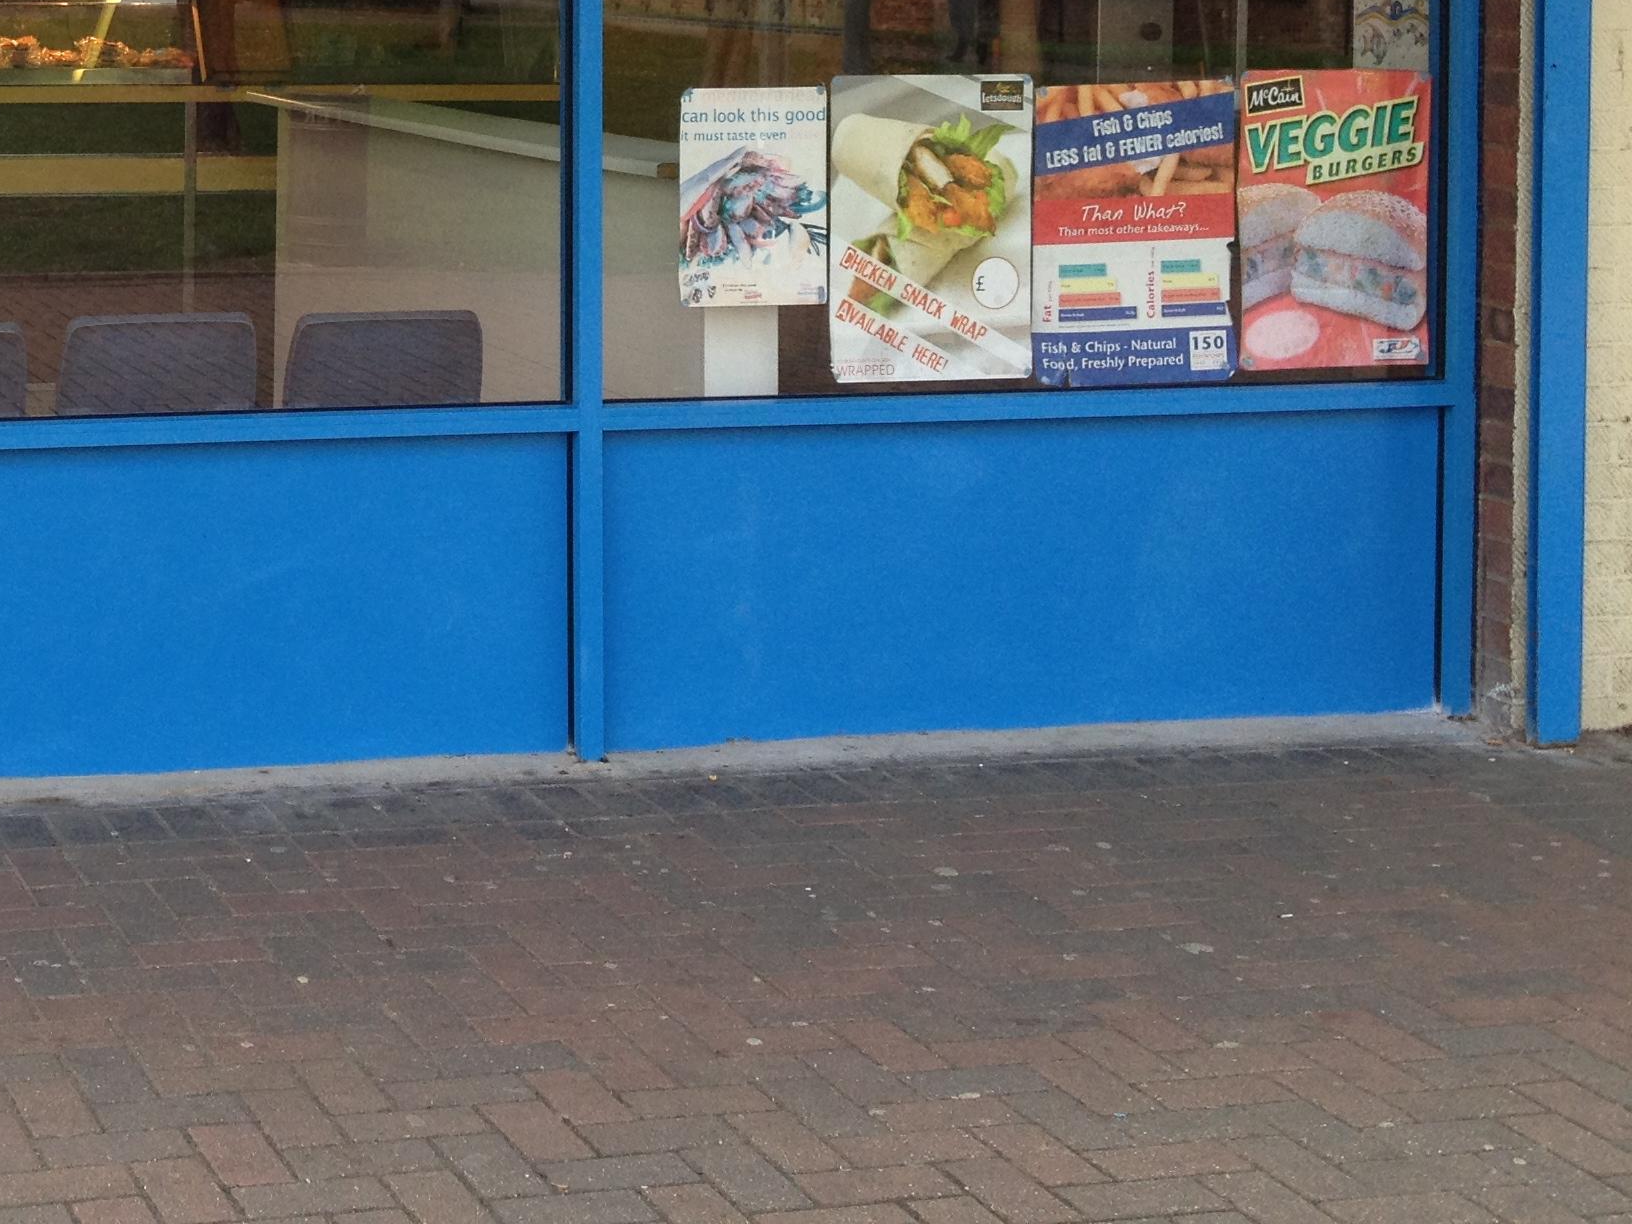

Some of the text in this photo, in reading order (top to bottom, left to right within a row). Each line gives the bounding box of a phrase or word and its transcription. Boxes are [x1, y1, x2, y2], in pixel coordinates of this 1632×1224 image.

[1249, 86, 1302, 109] McCain
[682, 107, 826, 125] can look this good
[1092, 110, 1172, 137] Fish & Chips
[681, 130, 688, 141] it
[693, 130, 724, 141] must
[727, 130, 756, 141] taste
[759, 130, 787, 141] even
[1246, 98, 1417, 171] VEGGIE
[1046, 122, 1224, 168] LESS fat & FEWER calories!
[1312, 147, 1417, 180] BURGERS
[1082, 201, 1186, 221] Than What?
[1058, 226, 1085, 236] Than
[1087, 226, 1114, 236] most
[1116, 224, 1144, 234] other
[976, 275, 986, 292] £
[839, 246, 897, 292] CHICKEN
[900, 283, 947, 320] SNACK
[950, 310, 988, 342] WRAP
[1145, 270, 1155, 319] Calories
[1042, 304, 1052, 323] Fat
[835, 299, 949, 374] AVAILABLE HERE!
[1191, 335, 1225, 351] 150
[1041, 342, 1067, 354] Fish
[1071, 342, 1081, 353] &
[1085, 341, 1121, 355] Chips
[1131, 338, 1177, 351] Natural
[837, 364, 896, 377] WRAPPED
[1042, 359, 1078, 371] Food,
[1082, 356, 1124, 371] Freshly
[1128, 354, 1184, 369] Prepared
